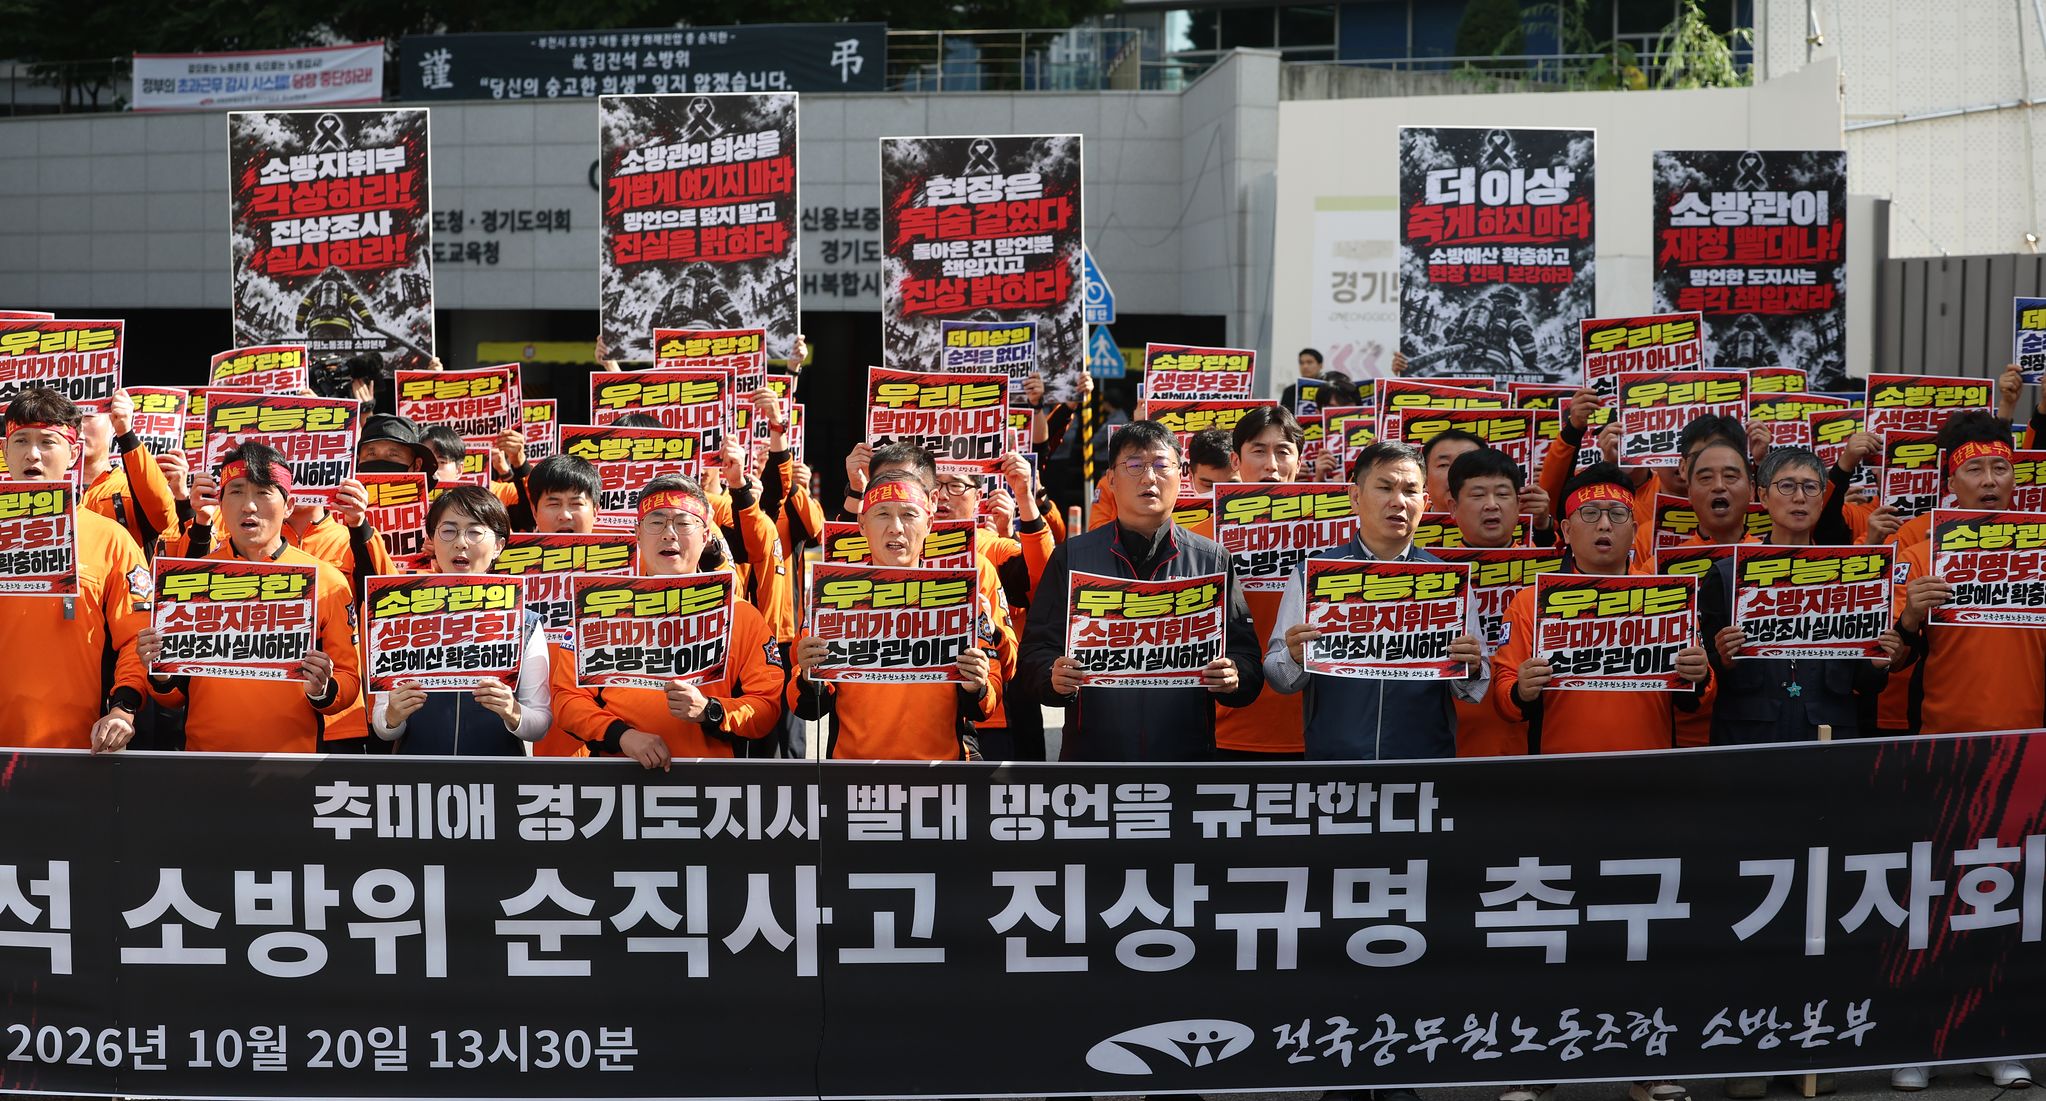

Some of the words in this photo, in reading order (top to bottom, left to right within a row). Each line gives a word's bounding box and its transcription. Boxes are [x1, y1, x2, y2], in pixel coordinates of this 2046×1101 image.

[419, 48, 454, 89] 謹
[593, 52, 636, 71] 김진석
[643, 51, 690, 70] 소방위
[830, 38, 864, 83] 弔
[143, 78, 175, 93] 정부의
[178, 77, 223, 93] 초과근무
[226, 76, 249, 93] 감시
[545, 76, 597, 96] 숭고한
[652, 75, 686, 93] 잊지
[694, 71, 792, 92] 않겠습니다.
[260, 146, 405, 185] 소방지휘부
[618, 142, 708, 174] 소방관의
[710, 130, 780, 164] 희생을
[252, 170, 415, 215] 각성하라!
[608, 170, 676, 208] 가볍게
[679, 163, 744, 200] 여기지
[748, 155, 795, 194] 마라
[921, 172, 1043, 206] 현장은
[1425, 166, 1476, 205] 더
[1480, 166, 1576, 206] 이상
[481, 209, 571, 233] 경기도의회
[624, 209, 696, 232] 망언으로
[700, 206, 736, 226] 덮지
[739, 202, 776, 225] 말고
[898, 204, 972, 242] 목숨
[975, 196, 1072, 236] 걸었다
[1407, 203, 1475, 240] 죽게
[1478, 202, 1530, 236] 하지
[1534, 200, 1591, 239] 마라
[1670, 190, 1829, 226] 소방관이
[270, 210, 393, 247] 진상조사
[614, 229, 695, 264] 진실을
[701, 221, 789, 255] 밝혀라
[1662, 227, 1729, 261] 재정
[1734, 219, 1843, 261] 빨대냐!
[266, 233, 407, 273] 실시하라!
[913, 240, 970, 260] 돌아온
[972, 239, 992, 257] 건
[995, 235, 1053, 255] 망언뿐
[1429, 248, 1498, 266] 소방예산
[1502, 248, 1570, 266] 확충하고
[942, 256, 1025, 278] 책임지고
[1428, 265, 1466, 283] 현장
[1469, 265, 1502, 283] 인력
[1508, 265, 1574, 284] 보강하라
[1690, 268, 1745, 286] 망언한
[1747, 269, 1816, 285] 도지사는
[901, 277, 968, 311] 진상
[971, 267, 1072, 306] 밝혀라
[1678, 287, 1730, 310] 즉각
[1734, 284, 1835, 310] 책임져라
[0, 329, 115, 356] 우리는
[660, 334, 760, 358] 소방관의
[947, 330, 967, 347] 더
[968, 327, 1030, 346] 이상의
[1589, 321, 1695, 353] 우리는
[0, 355, 55, 381] 빨대가
[58, 352, 115, 377] 아니다
[214, 351, 301, 380] 소방관의
[948, 350, 993, 365] 순직은
[996, 345, 1032, 361] 없다!
[1152, 354, 1248, 372] 소방관의
[1589, 352, 1645, 378] 빨대가
[1646, 342, 1700, 369] 아니다
[402, 376, 502, 401] 무능한
[599, 381, 719, 409] 우리는
[875, 384, 1000, 408] 우리는
[1153, 373, 1248, 392] 생명보호!
[1626, 380, 1742, 408] 우리는
[1874, 386, 1987, 408] 소방관의
[214, 406, 350, 433] 무능한
[406, 396, 504, 422] 소방지휘부
[873, 410, 937, 434] 빨대가
[939, 408, 1001, 435] 아니다
[569, 437, 693, 460] 소방관의
[868, 483, 892, 503] 단결
[1224, 494, 1352, 524] 우리는
[1223, 525, 1291, 552] 빨대가
[495, 545, 629, 575] 우리는
[1744, 555, 1885, 587] 무능한
[162, 573, 307, 601] 무능한
[375, 584, 515, 618] 소방관의
[584, 584, 724, 617] 우리는
[821, 579, 968, 609] 우리는
[1077, 584, 1217, 618] 무능한
[1315, 572, 1460, 601] 무능한
[1745, 583, 1883, 618] 소방지휘부
[163, 603, 306, 633] 소방지휘부
[1316, 602, 1458, 634] 소방지휘부
[1545, 587, 1687, 619] 우리는
[378, 613, 516, 651] 생명보호!
[583, 620, 655, 649] 빨대가
[658, 610, 725, 647] 아니다
[818, 612, 893, 639] 빨대가
[896, 607, 969, 639] 아니다
[1075, 612, 1217, 648] 소방지휘부
[1543, 621, 1617, 651] 빨대가
[1619, 614, 1689, 647] 아니다
[1742, 617, 1812, 643] 진상조사
[1812, 611, 1887, 642] 실시하라!
[160, 633, 231, 660] 진상조사
[233, 632, 310, 660] 실시하라!
[375, 647, 444, 674] 소방예산
[445, 643, 518, 670] 확충하라!
[585, 638, 724, 675] 소방관이다
[824, 636, 970, 667] 소방관이다
[1073, 648, 1145, 672] 진상조사
[1146, 639, 1220, 672] 실시하라!
[1313, 634, 1384, 660] 진상조사
[313, 780, 496, 841] 추미애
[516, 784, 827, 842] 경기도지사
[846, 783, 968, 841] 빨대
[989, 782, 1172, 842] 망언을
[1192, 781, 1455, 839] 규탄한다.
[0, 860, 73, 976] 석
[120, 864, 448, 978] 소방위
[494, 864, 946, 979] 순직사고
[987, 859, 1429, 974] 진상규명
[1474, 856, 1691, 964] 촉구
[1730, 834, 2046, 957] 기자회
[1272, 1006, 1679, 1067] 전국공무원노동조합
[1700, 998, 1877, 1051] 소방본부
[5, 1024, 167, 1071] 2026년
[187, 1025, 289, 1072] 10월
[306, 1024, 409, 1072] 20일
[428, 1025, 639, 1073] 13시30분
